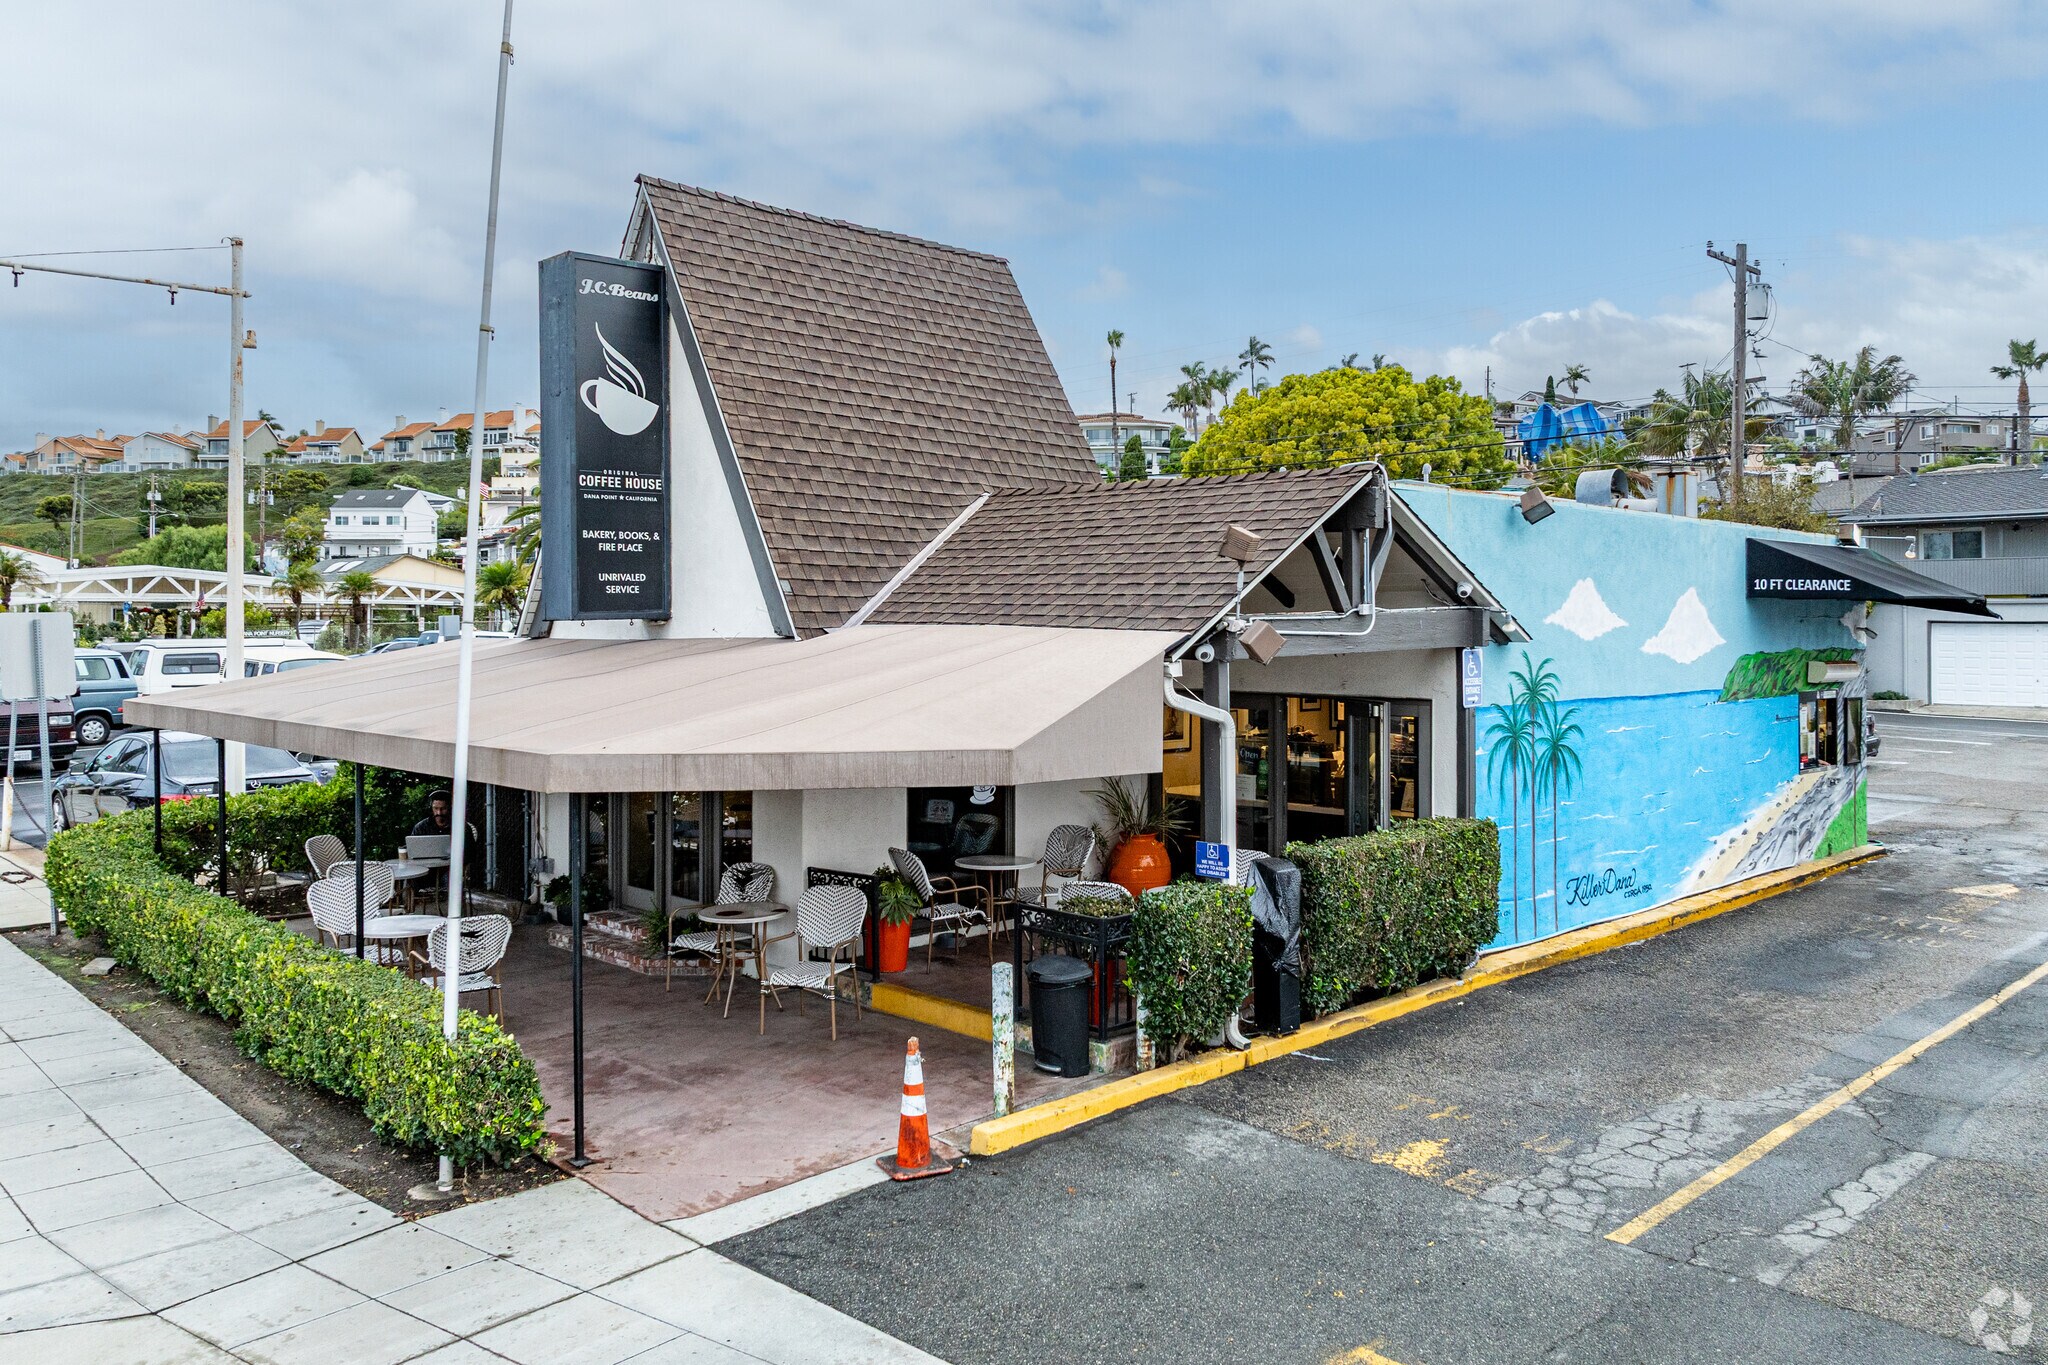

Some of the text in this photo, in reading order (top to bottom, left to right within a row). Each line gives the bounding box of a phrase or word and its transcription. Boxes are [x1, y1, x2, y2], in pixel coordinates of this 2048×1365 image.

[579, 474, 662, 490] COFFEE HOUSE
[582, 530, 660, 541] BAKERY, BOOKS, &
[598, 542, 643, 552] FIRE PLACE
[598, 573, 646, 582] UNRIVALED
[605, 585, 640, 594] SERVICE
[1754, 578, 1851, 591] 10 FT CLEARANCE
